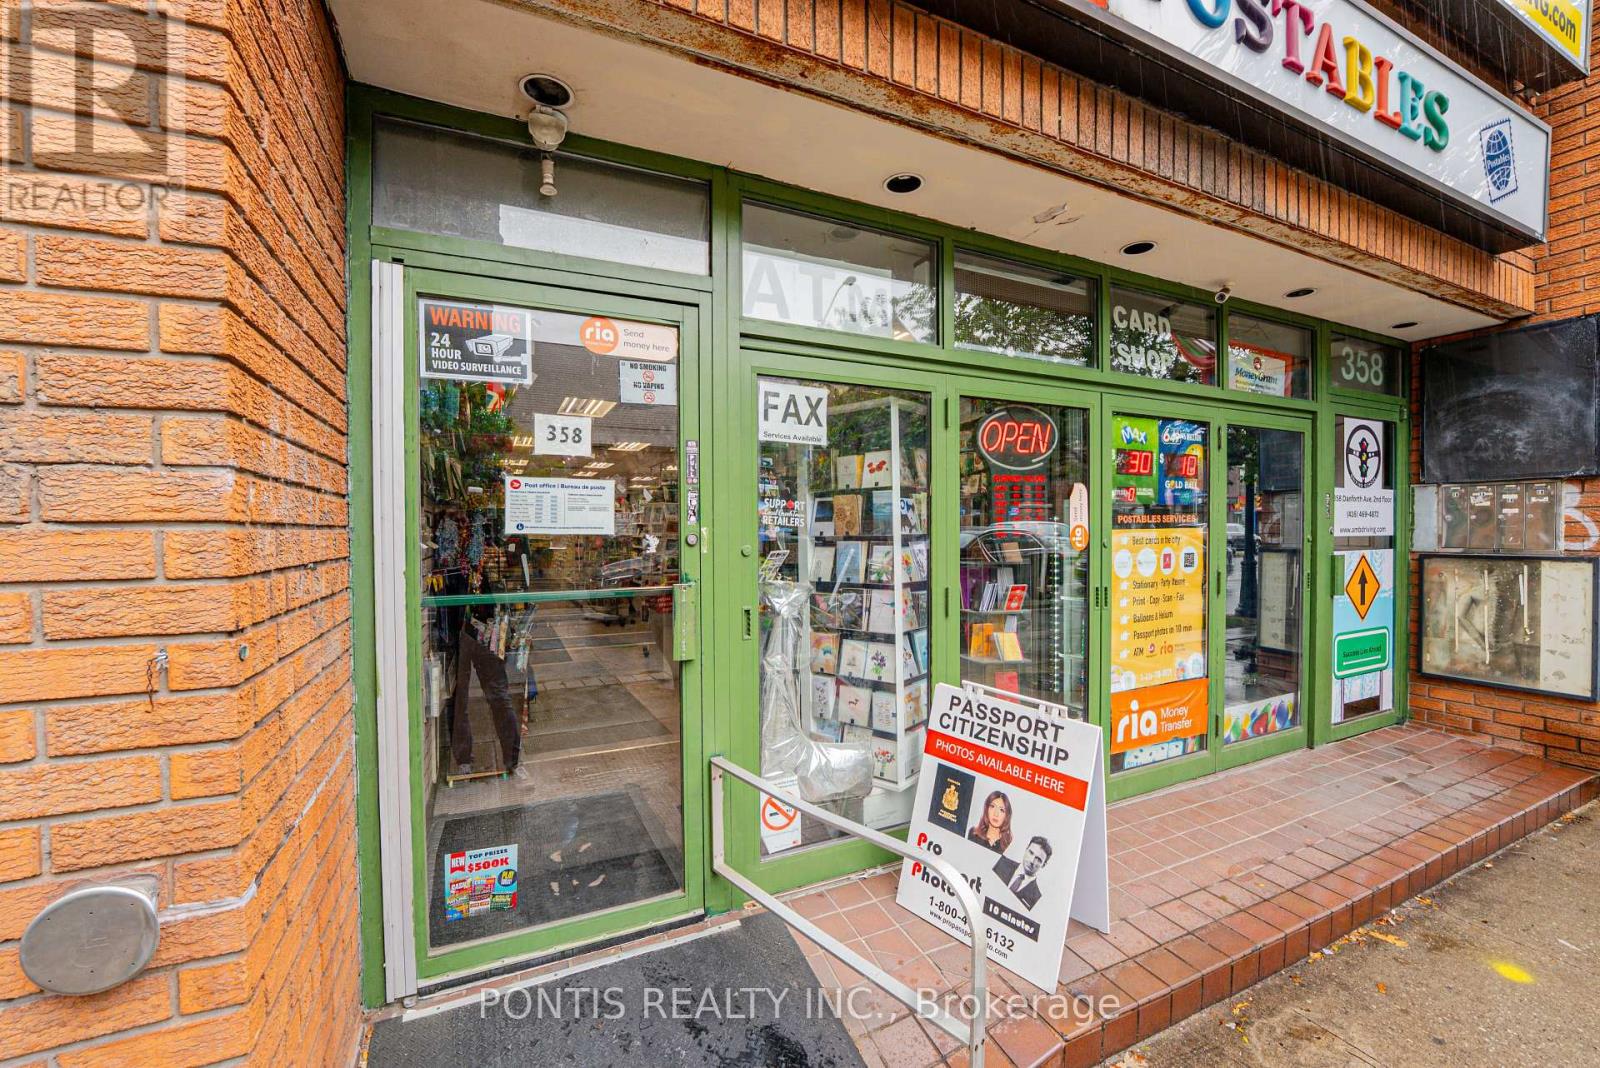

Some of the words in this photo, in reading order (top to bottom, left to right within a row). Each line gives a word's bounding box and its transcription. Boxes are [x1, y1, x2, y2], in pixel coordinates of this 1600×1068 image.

[1153, 0, 1450, 152] STABLES
[430, 305, 521, 333] WARNING
[1112, 305, 1172, 341] CARD
[430, 332, 451, 348] 24
[585, 321, 615, 341] ria
[623, 328, 645, 339] Send
[431, 347, 462, 360] HOUR
[623, 341, 651, 352] money
[431, 360, 459, 371] VIDEO
[460, 362, 522, 375] SURVEILLANCE
[629, 362, 638, 370] NO
[639, 363, 667, 373] SMOKING
[1116, 342, 1175, 375] SHOP
[1340, 346, 1384, 386] 358
[762, 390, 824, 427] FAX
[546, 424, 583, 444] 358
[763, 430, 792, 441] Services
[792, 432, 823, 443] Available
[982, 420, 1052, 454] OPEN
[1128, 450, 1152, 474] 30
[763, 497, 805, 511] SUPPORT
[762, 515, 805, 528] RETAILERS
[1117, 514, 1161, 524] POSTABLES
[1162, 514, 1197, 524] SERVICES
[1132, 596, 1146, 607] Print
[949, 695, 1065, 743] PASSPORT
[1116, 699, 1158, 744] ria
[1160, 705, 1189, 719] Money
[1160, 718, 1193, 733] Transfer
[939, 712, 1069, 766] CITIZENSHIP
[935, 738, 975, 762] PHOTOS
[976, 753, 1032, 783] AVAILABLE
[1034, 773, 1065, 794] HERE
[917, 832, 943, 856] Pro
[467, 856, 509, 873] $500K
[468, 852, 483, 860] TOP
[988, 902, 1000, 916] 10
[1000, 909, 1035, 935] minutes
